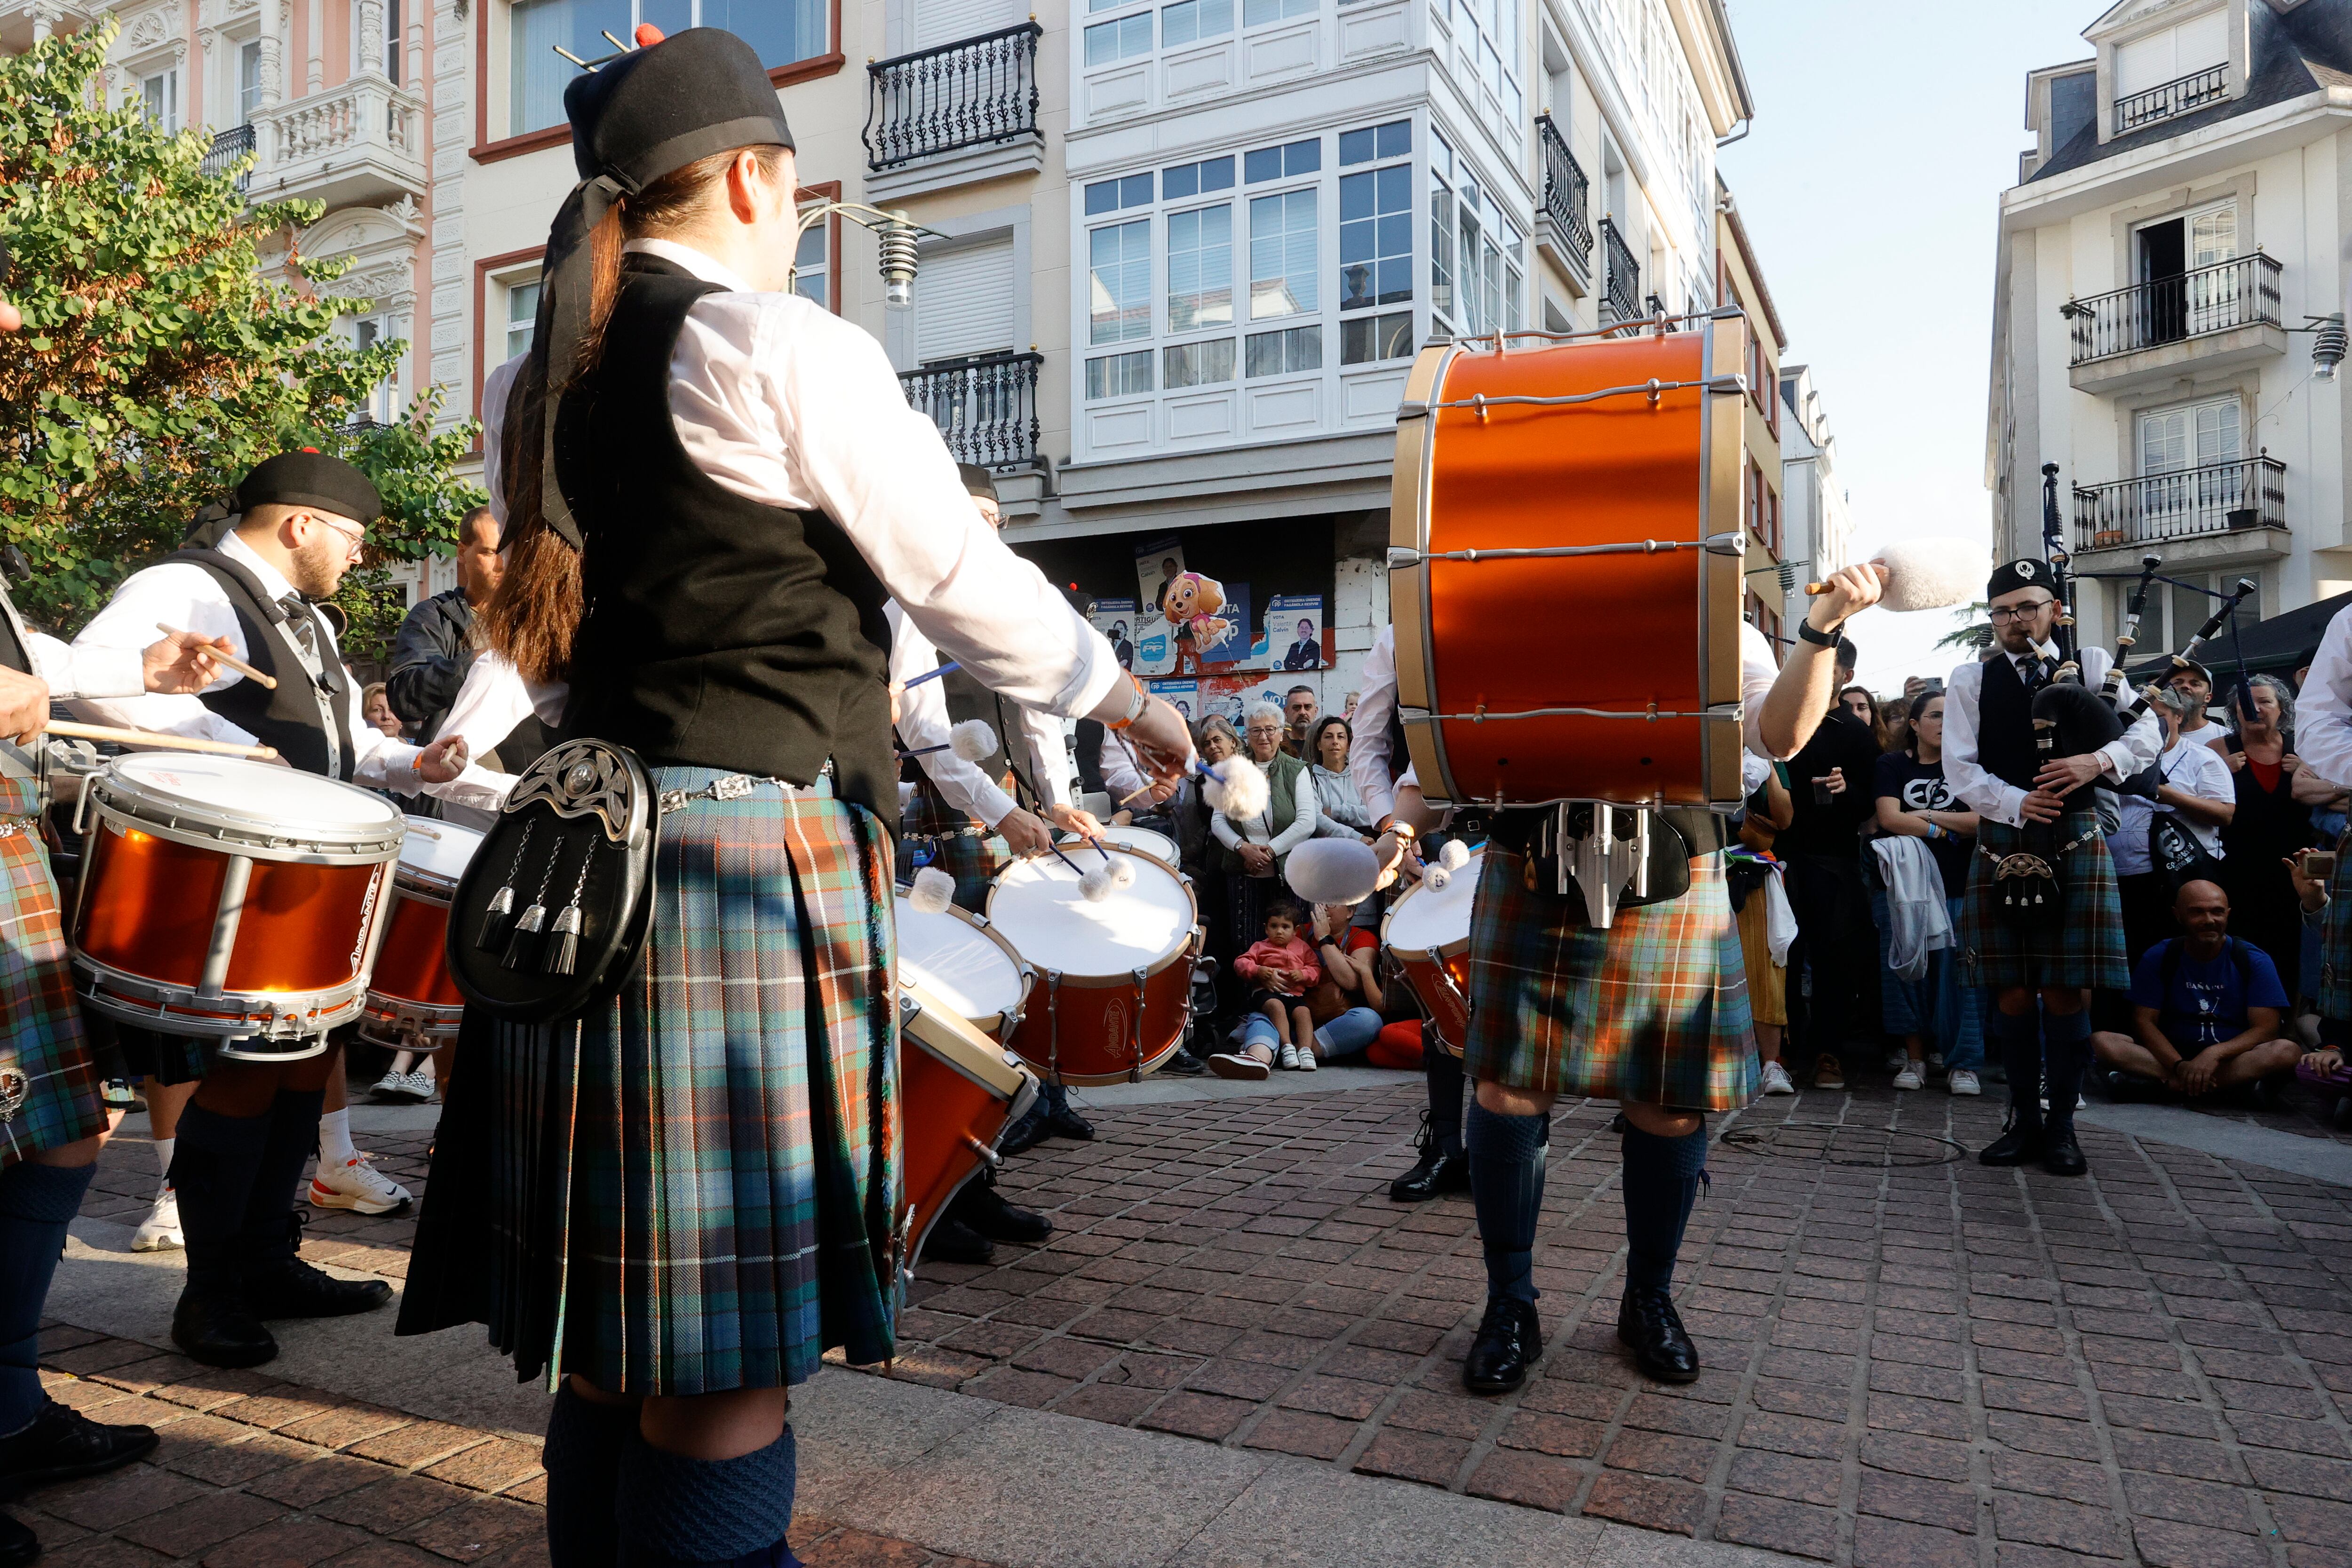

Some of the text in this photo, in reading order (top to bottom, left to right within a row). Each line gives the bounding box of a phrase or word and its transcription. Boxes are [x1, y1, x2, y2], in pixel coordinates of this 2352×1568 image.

[1264, 695, 1287, 705] VOT
[350, 881, 377, 977] ANDANTE
[1104, 1010, 1121, 1059] ANDANTE
